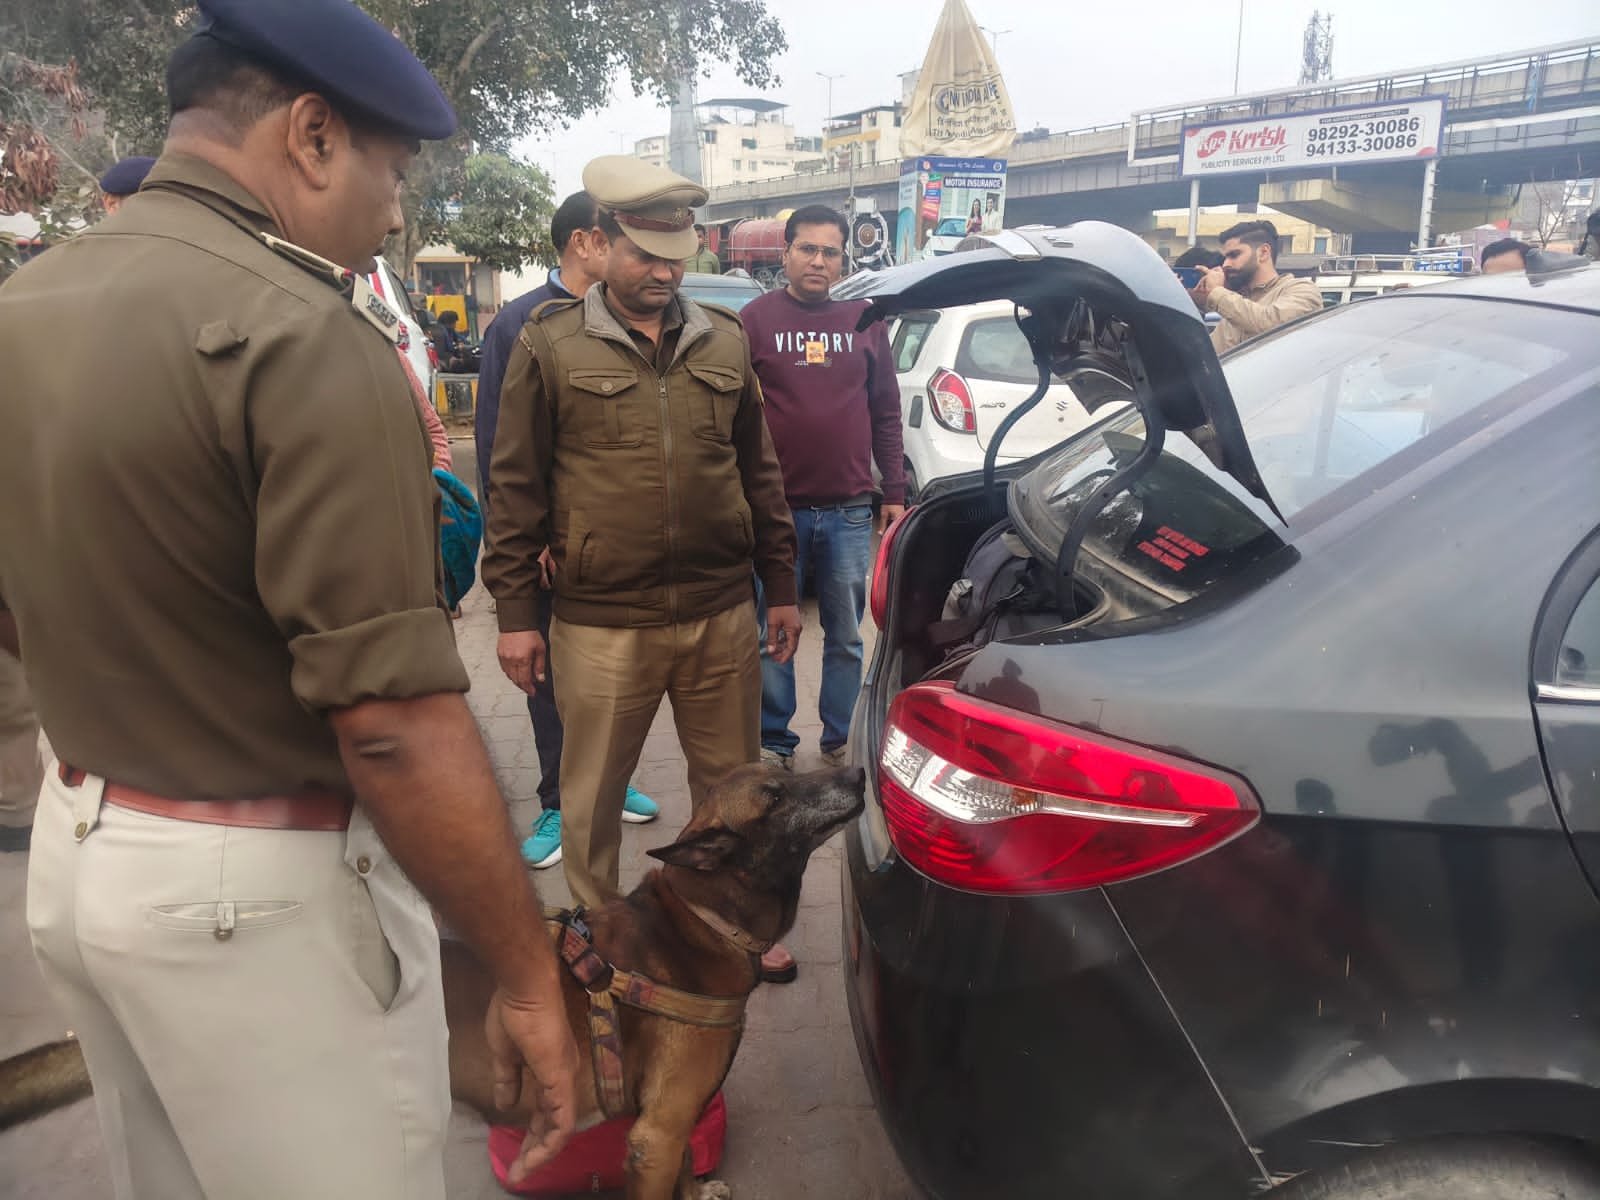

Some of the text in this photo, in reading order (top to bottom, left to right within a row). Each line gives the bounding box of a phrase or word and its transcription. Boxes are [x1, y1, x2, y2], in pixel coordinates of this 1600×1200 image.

[1308, 117, 1419, 142] 98292-30086
[1306, 134, 1417, 157] 94133-30086
[1201, 159, 1231, 169] PUBLICITY
[1232, 156, 1262, 166] SERVICES
[945, 178, 1001, 188] MOTOR INSURANCE
[775, 331, 853, 353] VICTORY
